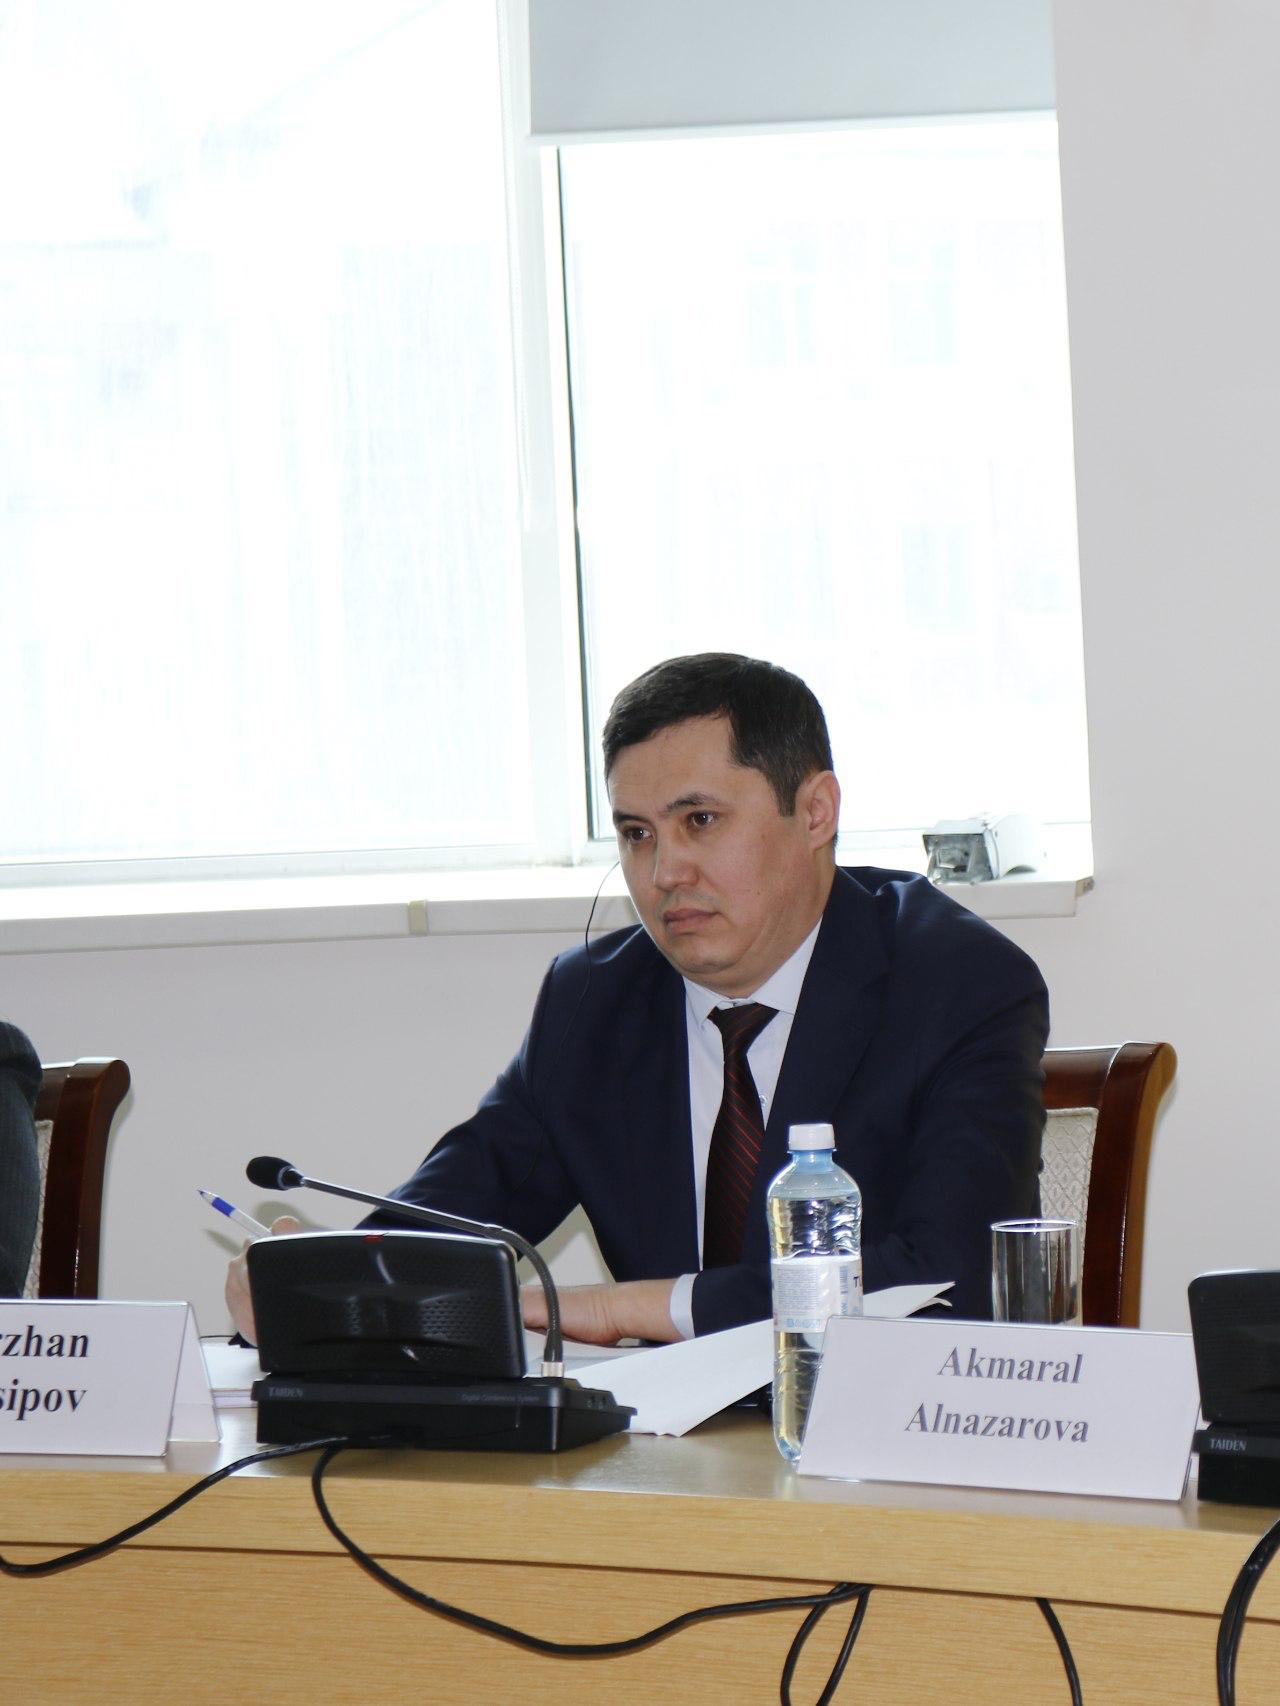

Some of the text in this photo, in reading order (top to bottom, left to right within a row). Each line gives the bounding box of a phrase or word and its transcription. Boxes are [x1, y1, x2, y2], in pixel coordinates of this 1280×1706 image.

[0, 1325, 88, 1358] zhan
[937, 1344, 1083, 1384] Akmaral
[904, 1401, 1089, 1443] Alnazarova
[1210, 1438, 1247, 1451] TAIDEN
